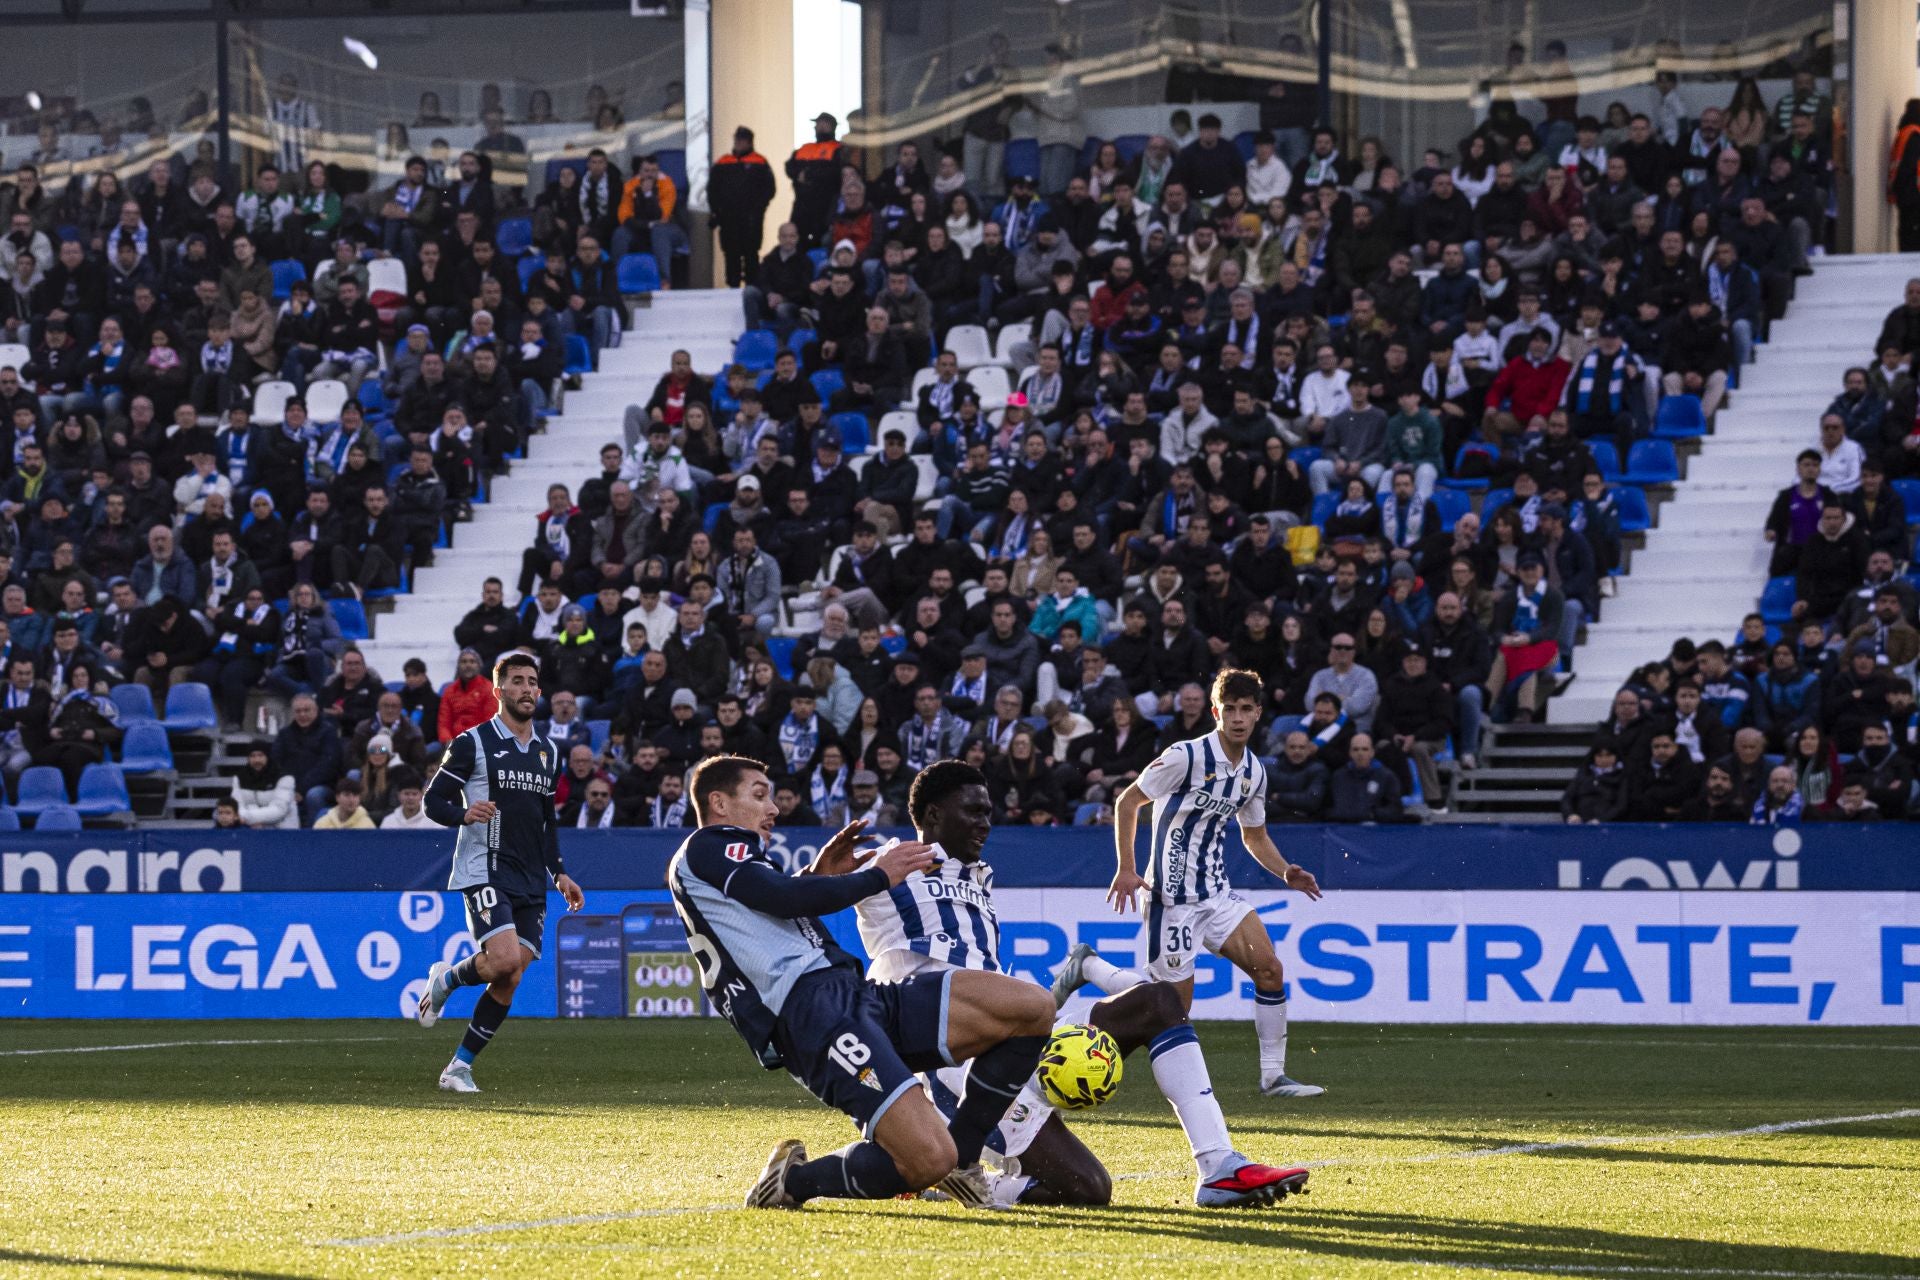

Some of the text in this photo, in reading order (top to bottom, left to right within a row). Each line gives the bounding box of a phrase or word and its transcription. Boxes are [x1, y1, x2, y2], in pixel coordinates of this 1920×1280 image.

[497, 769, 552, 788] BAHRAIN
[1194, 790, 1238, 817] Ontim
[472, 886, 498, 913] 10
[1166, 925, 1193, 952] 36
[75, 923, 337, 990] LEGA
[828, 1032, 872, 1078] 18
